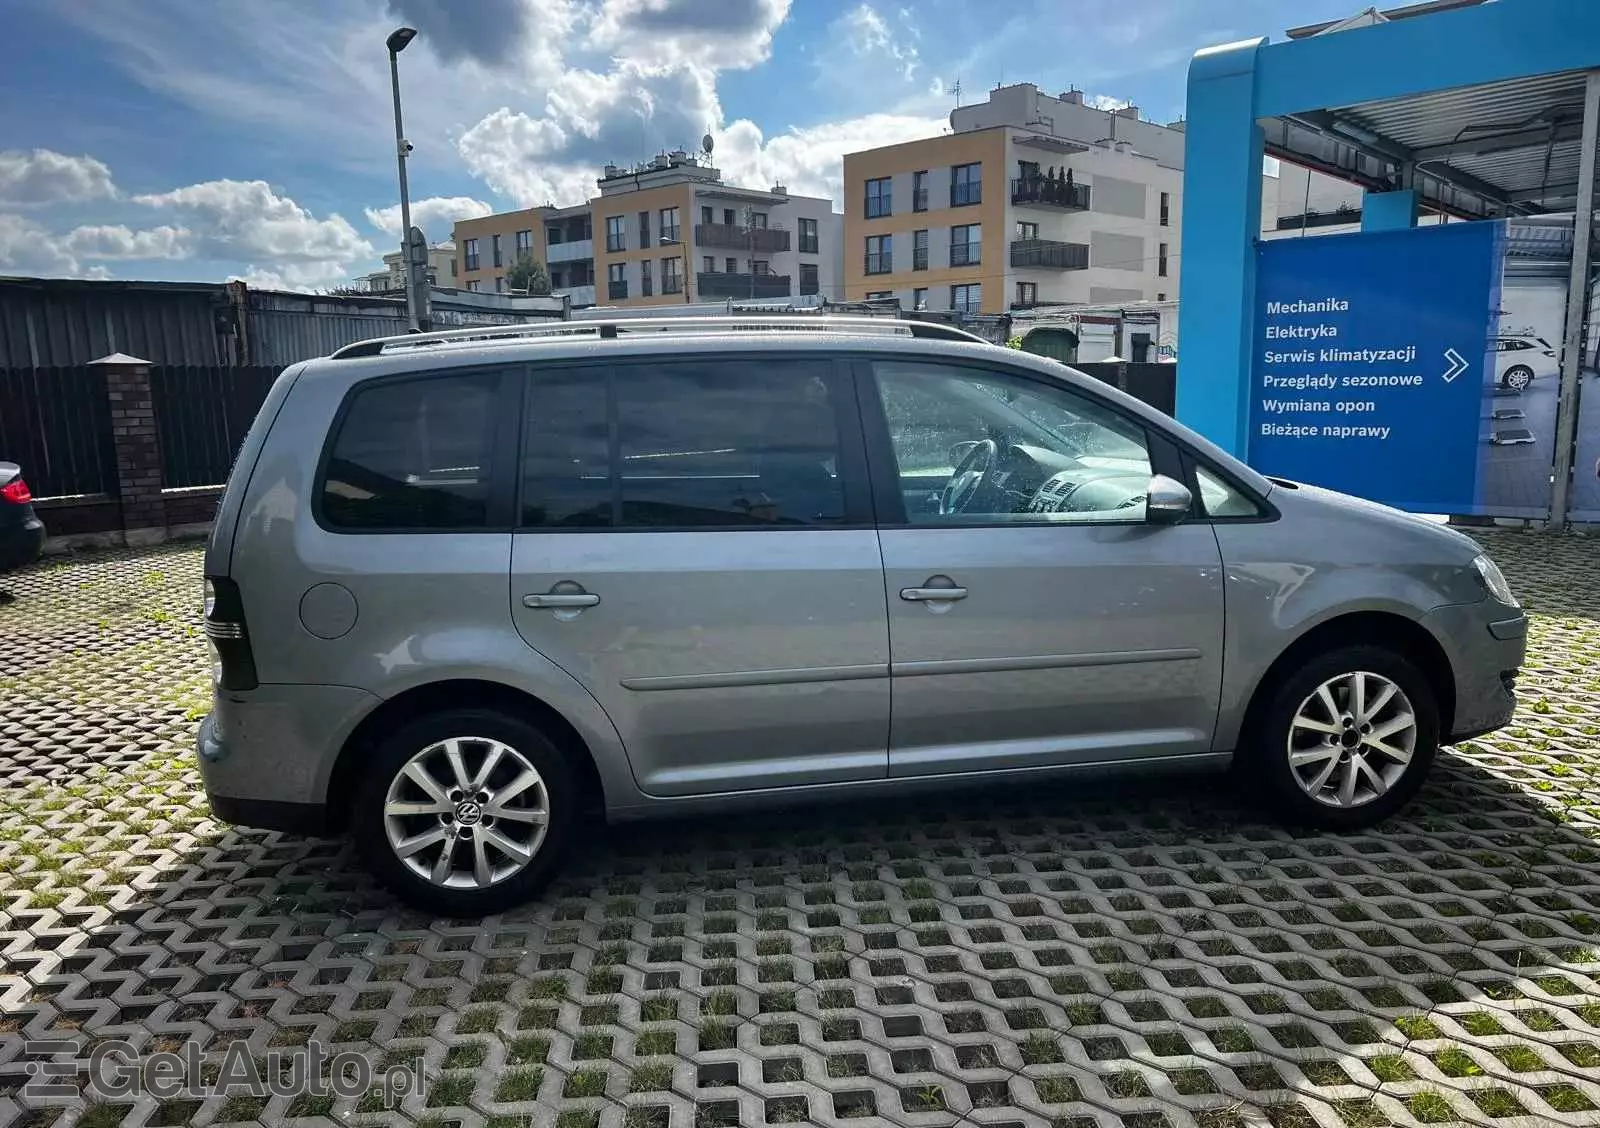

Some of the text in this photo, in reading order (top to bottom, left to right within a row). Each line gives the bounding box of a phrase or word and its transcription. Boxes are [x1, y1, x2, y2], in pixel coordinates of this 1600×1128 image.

[1266, 298, 1349, 314] Mechanika
[1265, 324, 1337, 340] Elektryka
[1264, 346, 1416, 363] Serwis klimatyzacji
[1263, 374, 1424, 390] Przeglądy sezonowe
[1262, 399, 1375, 414] Wymiana opon
[1261, 423, 1390, 439] Bieżące naprawy
